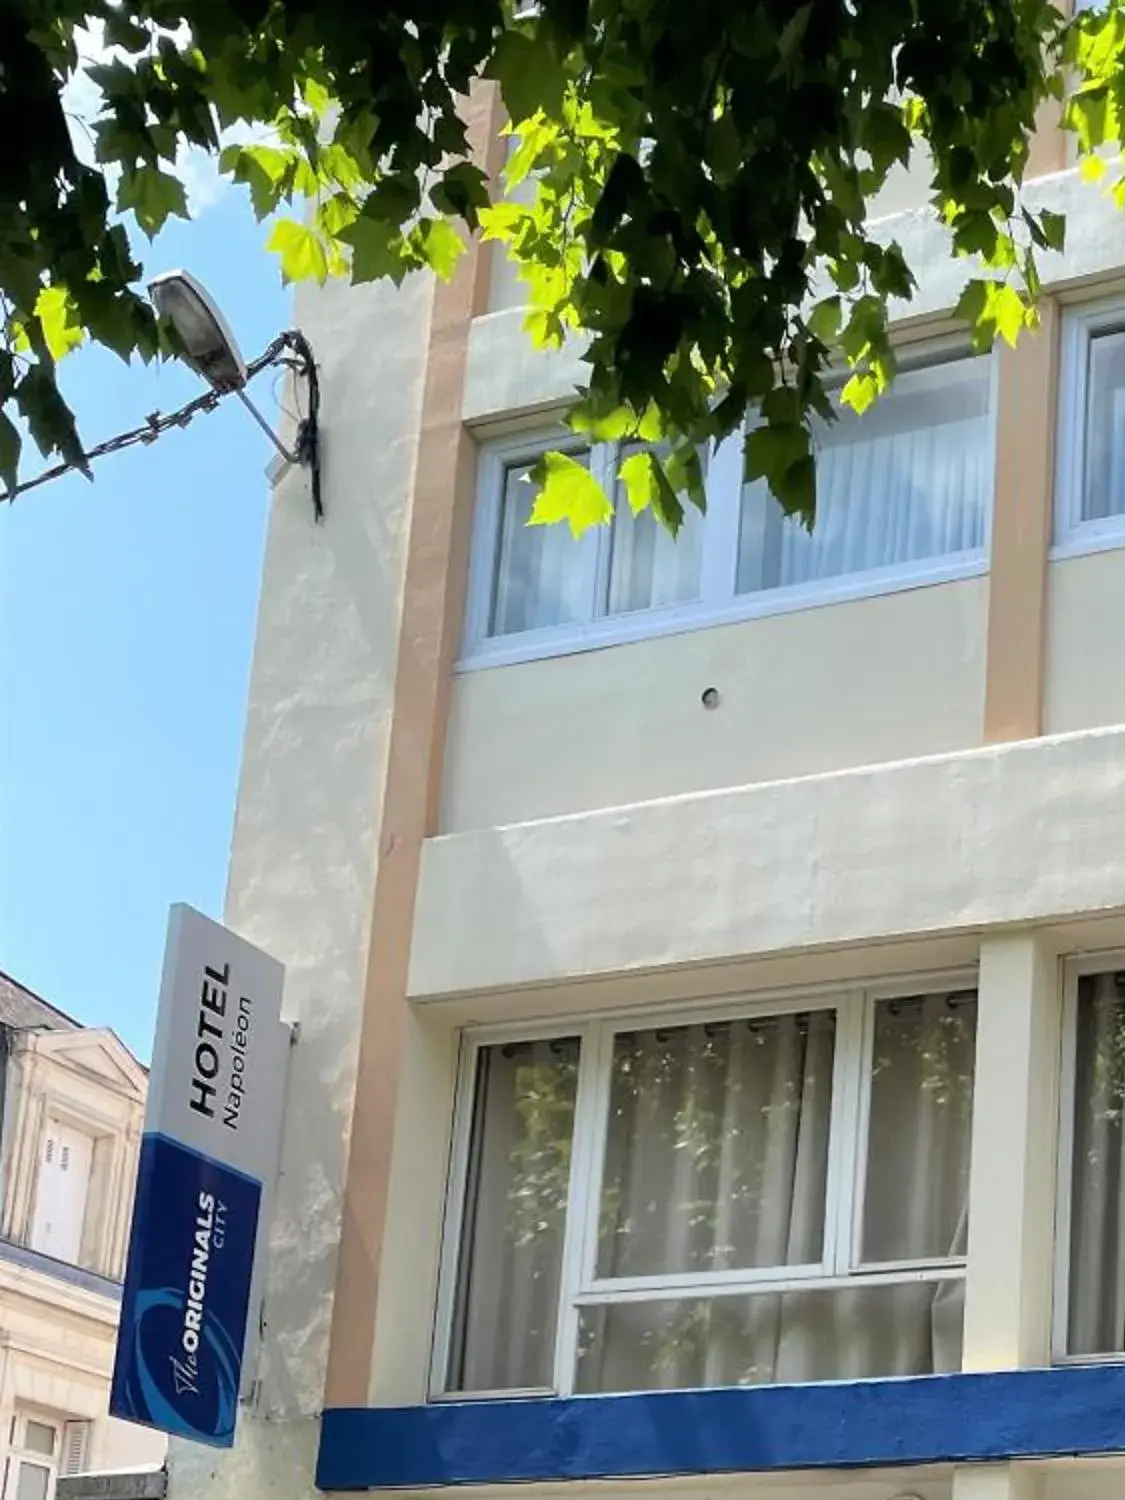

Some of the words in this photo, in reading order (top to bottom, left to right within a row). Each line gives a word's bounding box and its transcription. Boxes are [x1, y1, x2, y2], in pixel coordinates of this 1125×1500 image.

[190, 963, 229, 1118] HOTEL
[223, 997, 252, 1130] Napoléon
[183, 1191, 215, 1353] ORIGINALS
[213, 1199, 229, 1249] CITY
